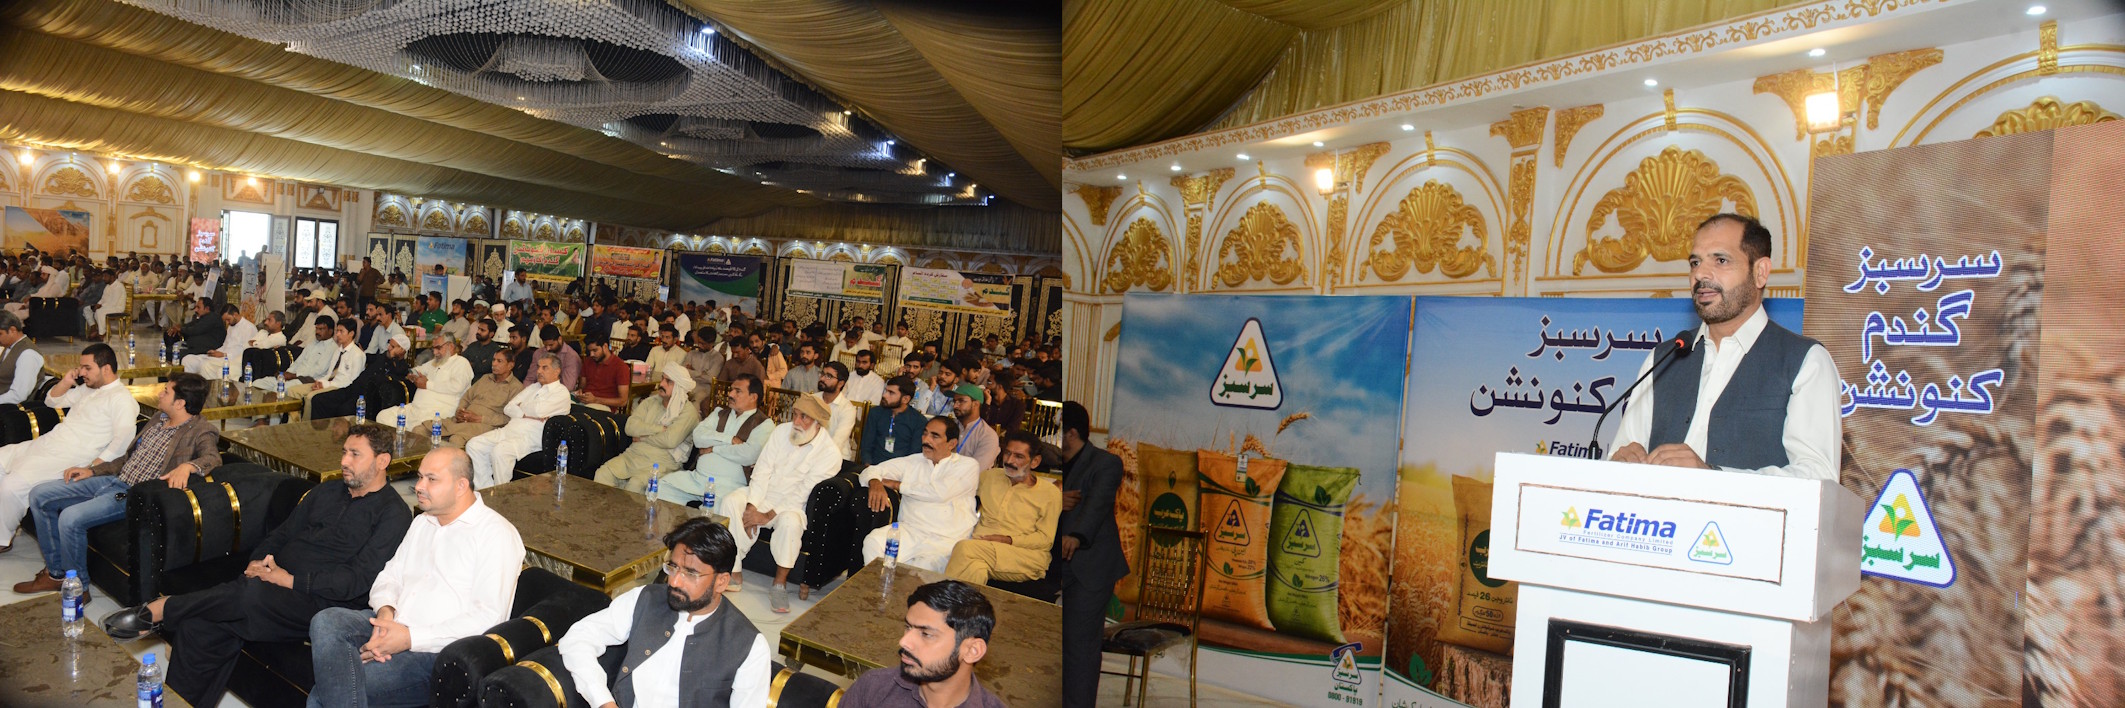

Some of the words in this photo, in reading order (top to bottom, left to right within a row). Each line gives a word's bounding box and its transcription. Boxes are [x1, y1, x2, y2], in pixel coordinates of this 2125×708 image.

[434, 241, 455, 250] Fatima
[544, 246, 570, 257] کسان
[1842, 245, 2004, 294] سرسبز
[849, 274, 883, 288] گندم
[1862, 290, 1974, 363] گندم
[1526, 315, 1663, 361] سرسبز
[1218, 373, 1274, 400] سرسبز
[1470, 366, 1616, 425] کنونشن
[1584, 508, 1677, 539] Fatima
[1219, 526, 1246, 543] سرسبز
[1583, 530, 1614, 538] Fertilizer
[1617, 533, 1645, 542] Company
[1648, 537, 1674, 545] Limited
[1287, 537, 1316, 552] سرسبز
[1578, 536, 1599, 544] Fatima
[1631, 542, 1650, 550] Habib
[1652, 545, 1673, 554] Group
[1862, 534, 1940, 571] سرسبز
[1694, 546, 1727, 560] سرسبز
[1480, 592, 1491, 601] 26
[1336, 668, 1358, 680] سرسبز
[1334, 682, 1358, 696] پاکستان
